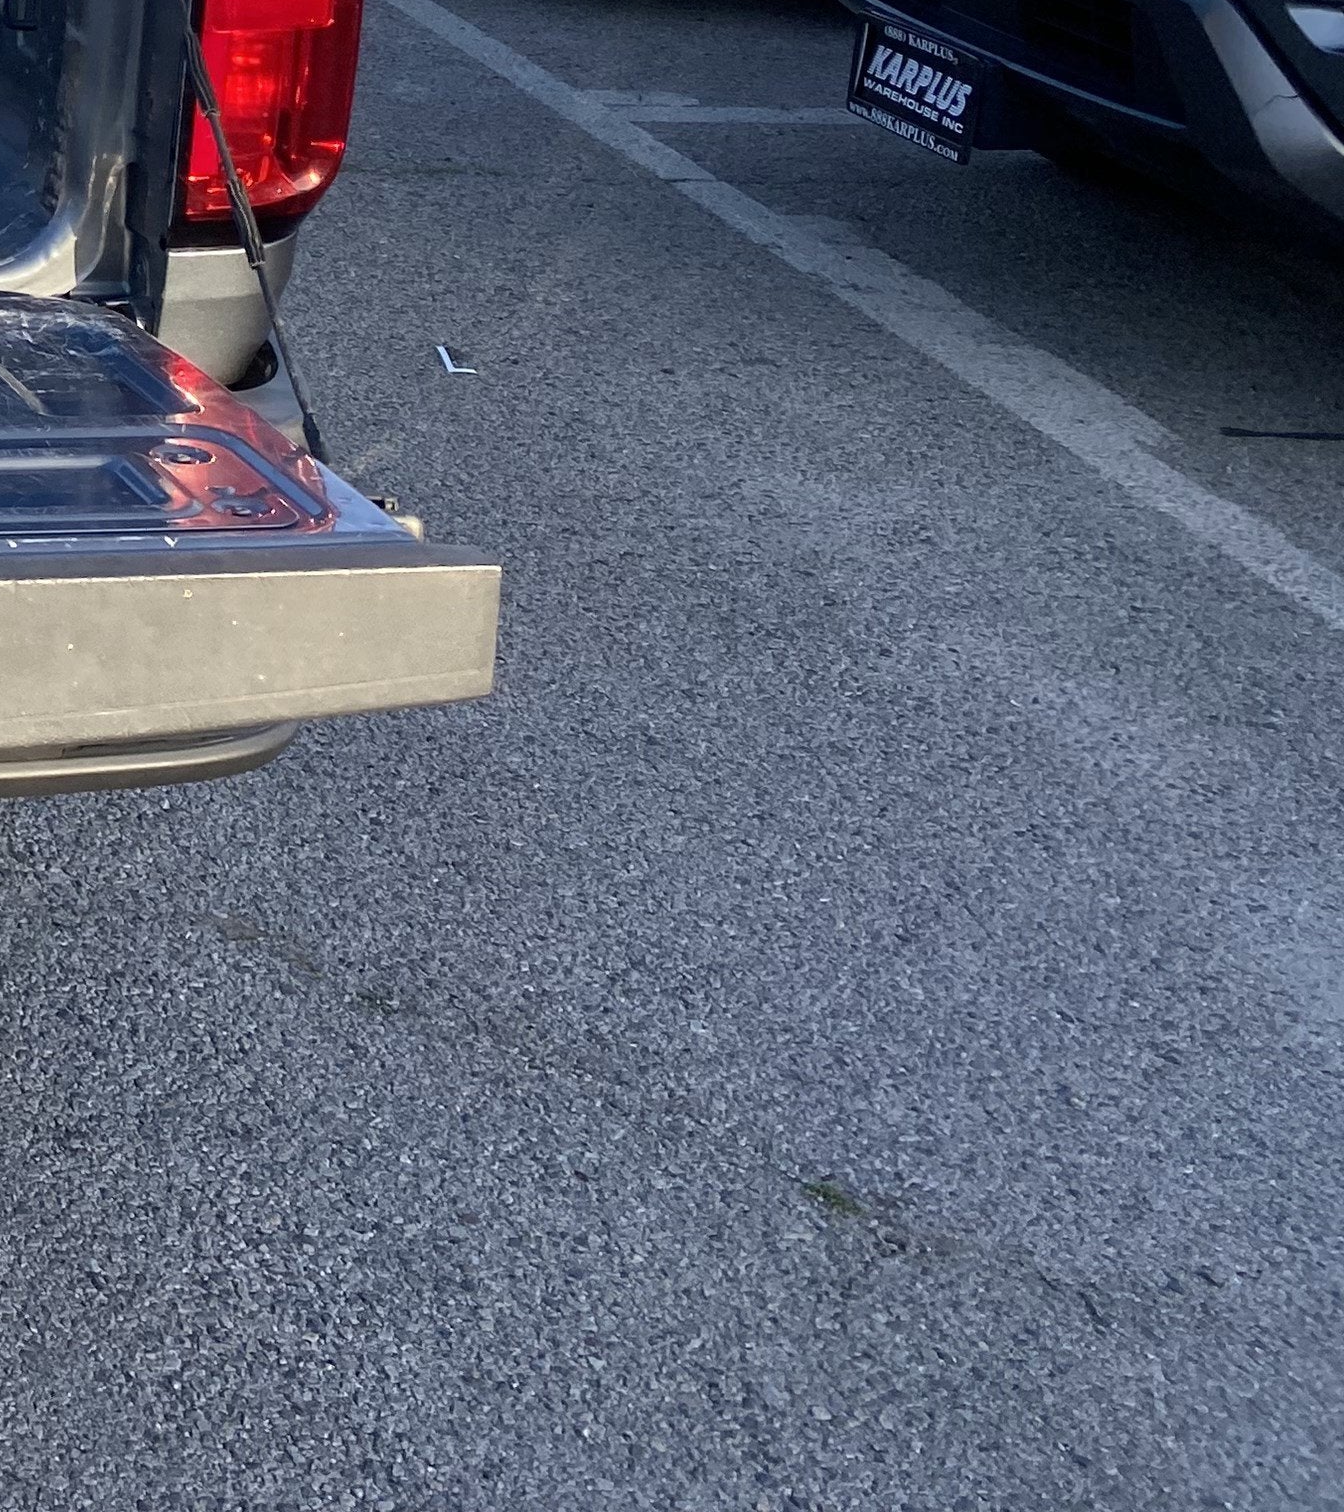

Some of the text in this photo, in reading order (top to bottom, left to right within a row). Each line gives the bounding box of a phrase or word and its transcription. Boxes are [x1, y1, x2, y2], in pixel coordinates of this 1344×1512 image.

[884, 25, 907, 43] (888)
[863, 76, 964, 134] WAREHOUSE INC
[866, 44, 973, 117] KARPLUS
